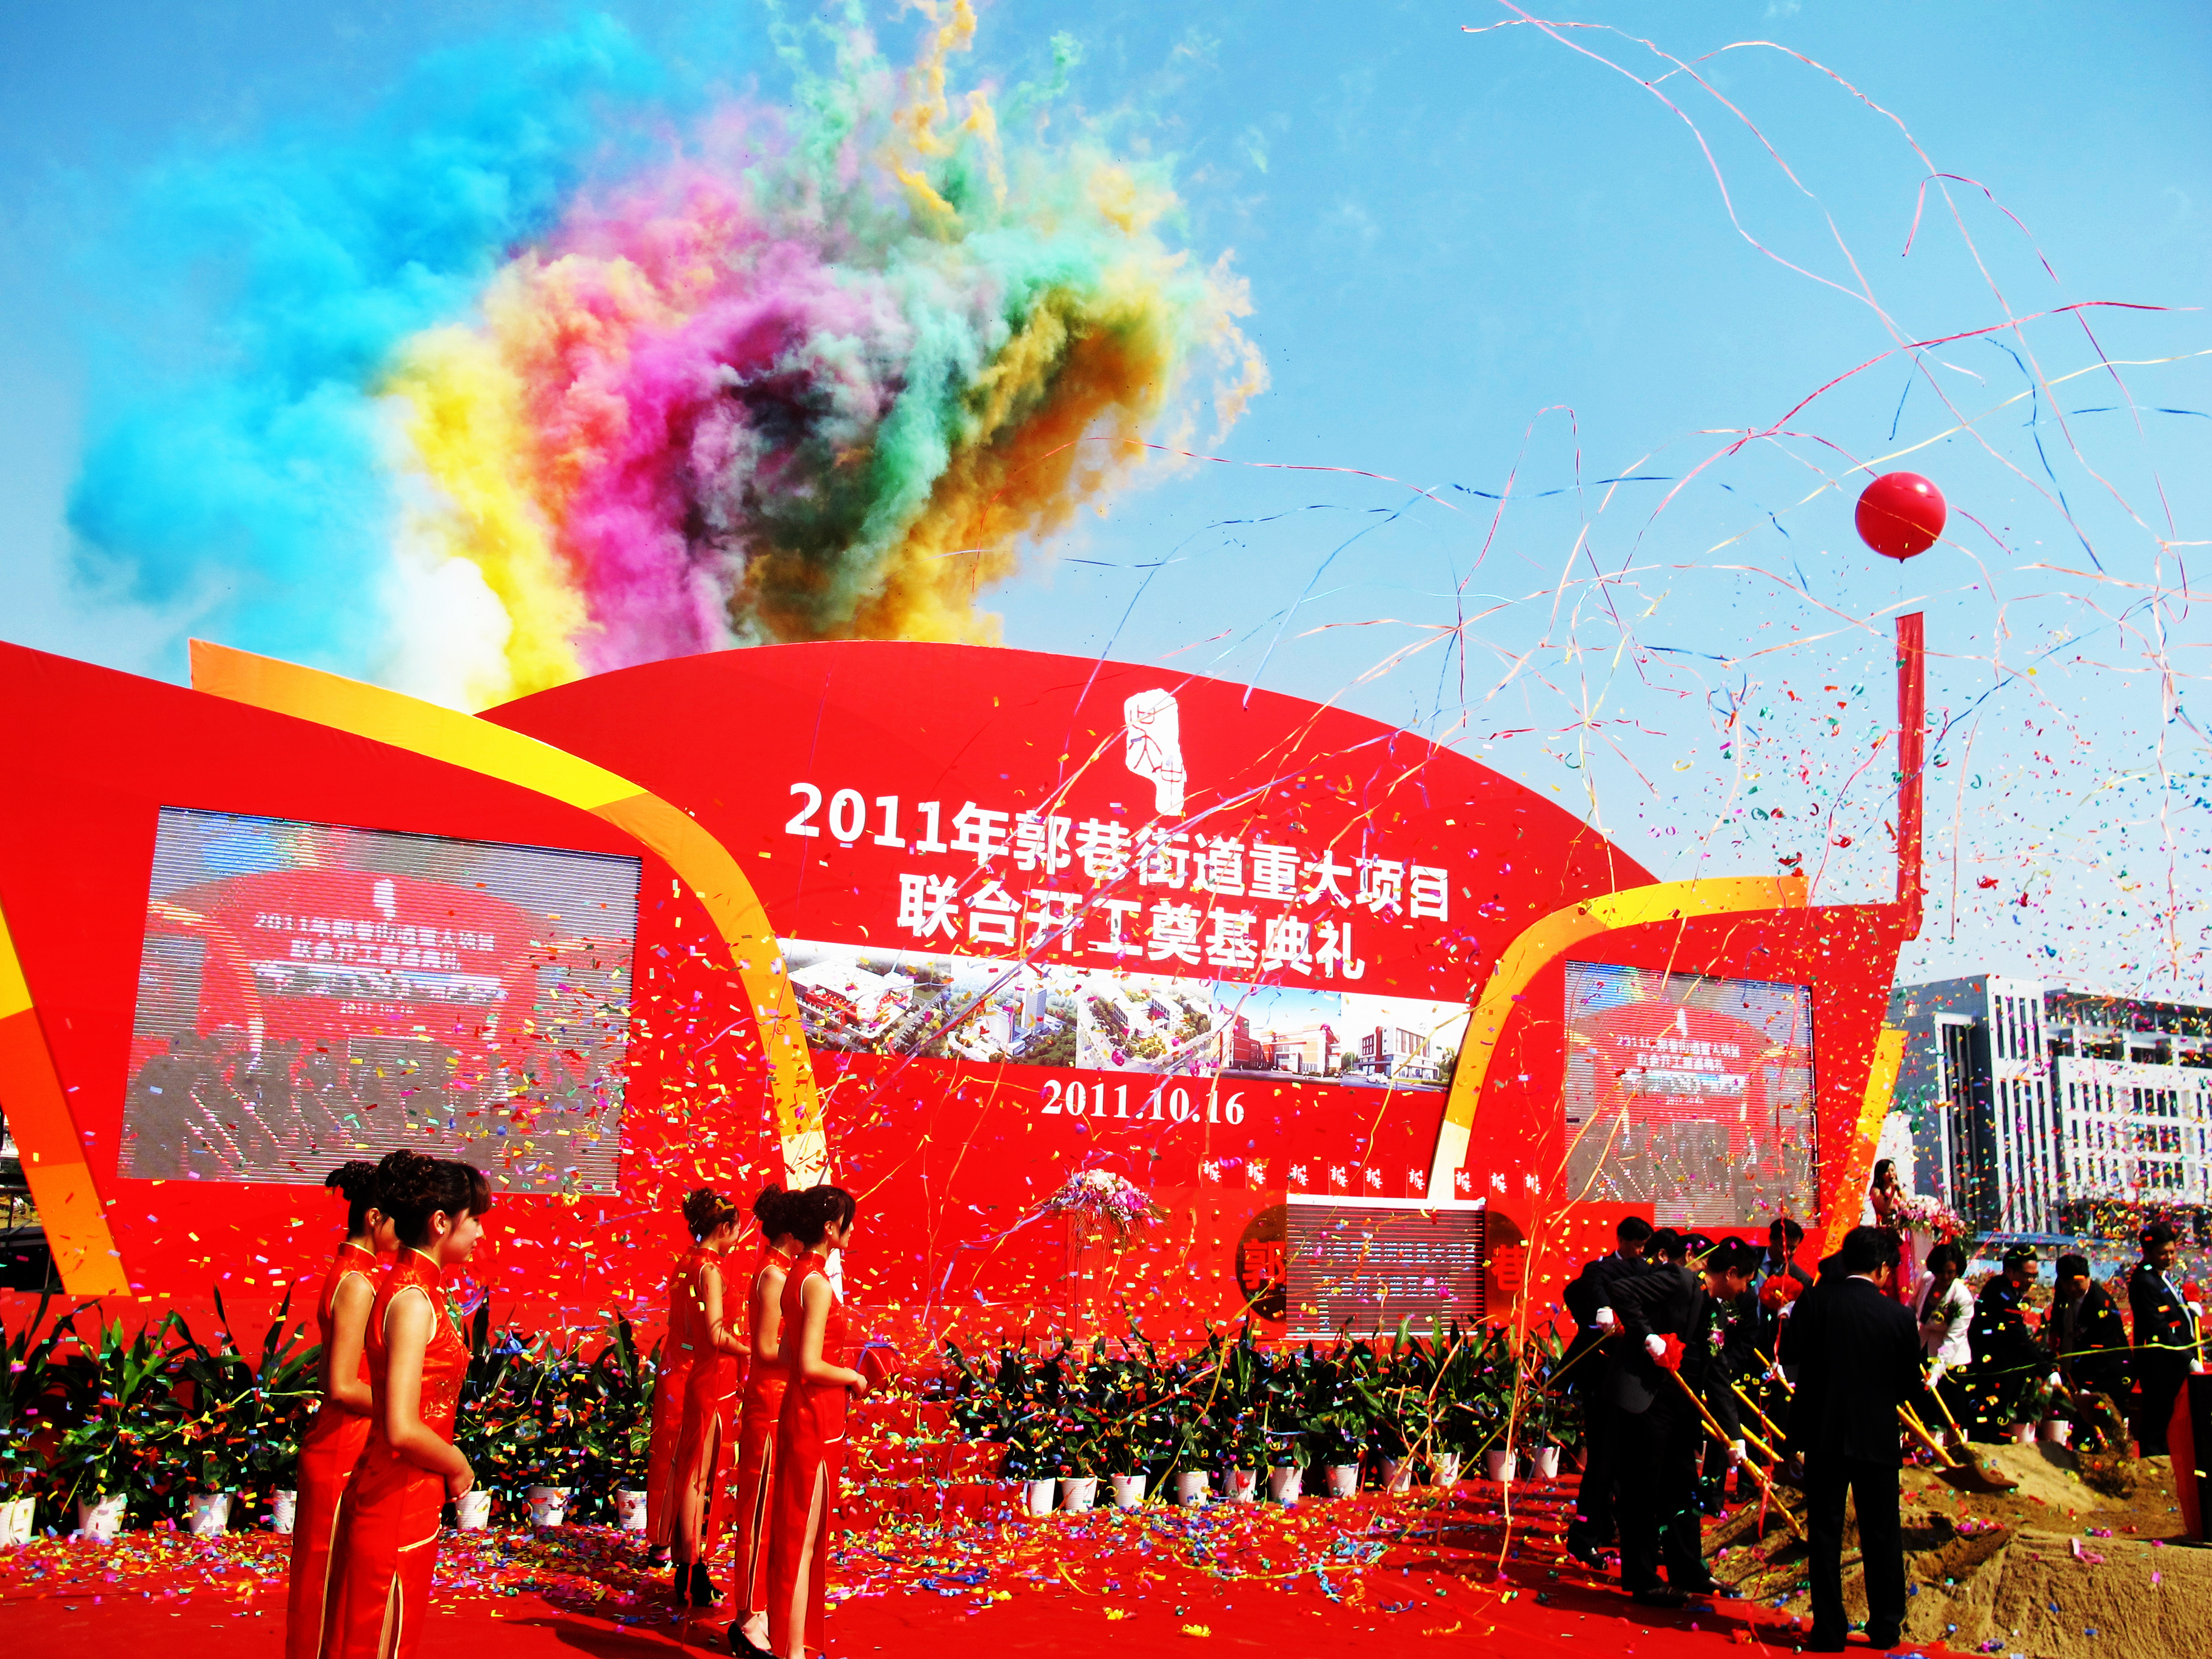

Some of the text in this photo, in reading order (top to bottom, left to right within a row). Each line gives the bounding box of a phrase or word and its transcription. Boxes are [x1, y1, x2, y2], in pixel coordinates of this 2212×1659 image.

[785, 782, 1449, 922] 2011年郭巷街道重大项目
[896, 873, 1366, 981] 联合开工奠基典礼
[1041, 1079, 1245, 1125] 2011.10.16
